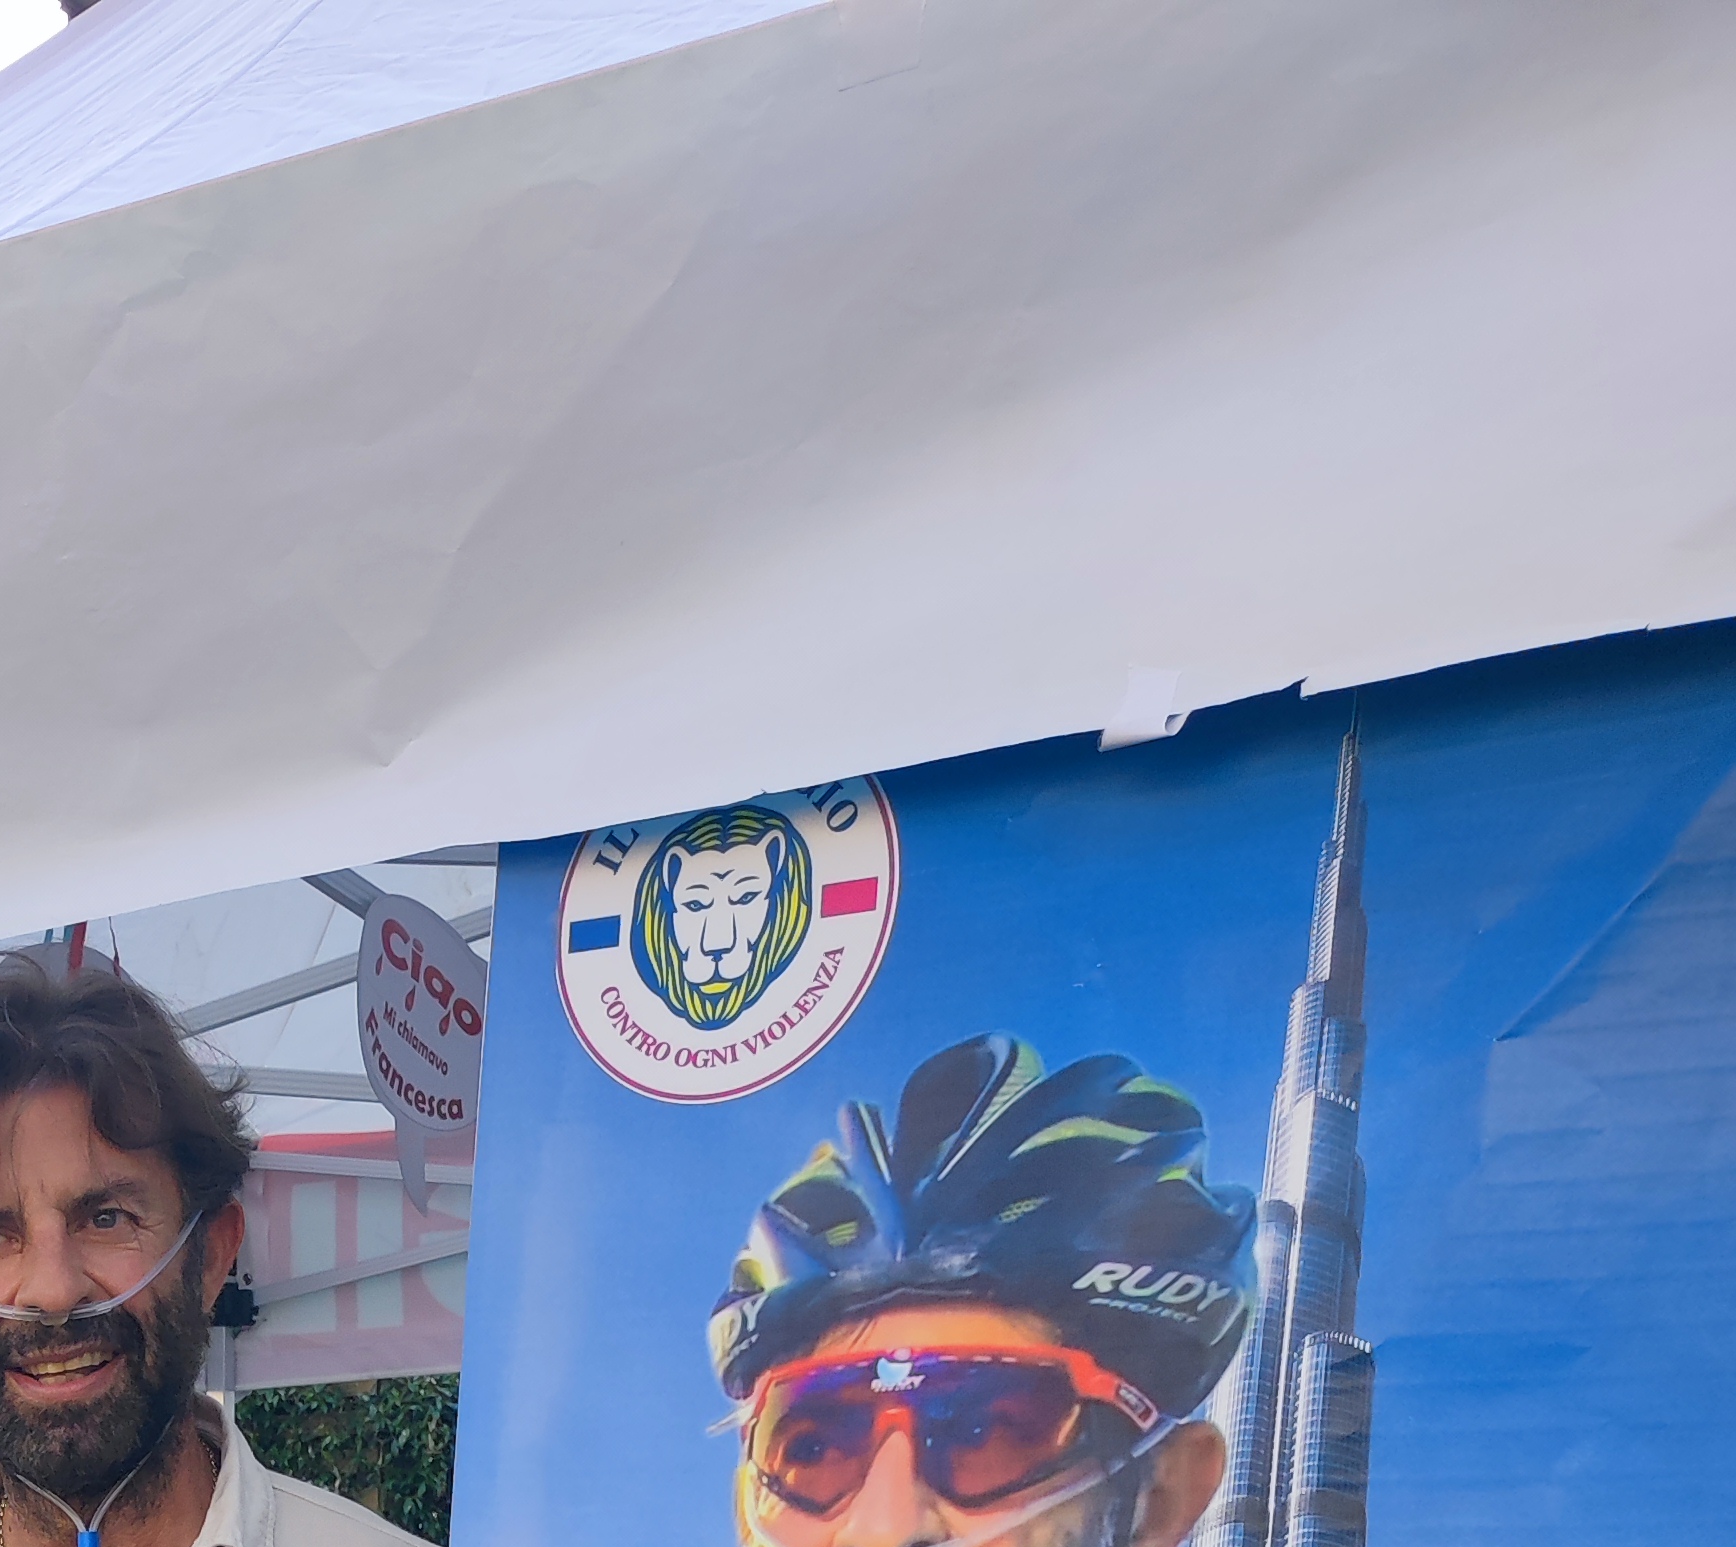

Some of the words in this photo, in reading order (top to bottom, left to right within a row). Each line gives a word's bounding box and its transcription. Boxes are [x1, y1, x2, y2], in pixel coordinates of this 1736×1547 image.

[592, 827, 640, 876] IL
[381, 918, 483, 1036] Ciao
[600, 986, 671, 1061] CONTRO
[674, 1043, 740, 1069] OGNI
[741, 946, 845, 1056] VIOLENZA
[365, 1007, 464, 1121] Francesca
[382, 1001, 396, 1030] Mi
[397, 1019, 448, 1076] chiamavo
[1072, 1261, 1232, 1312] RUDY
